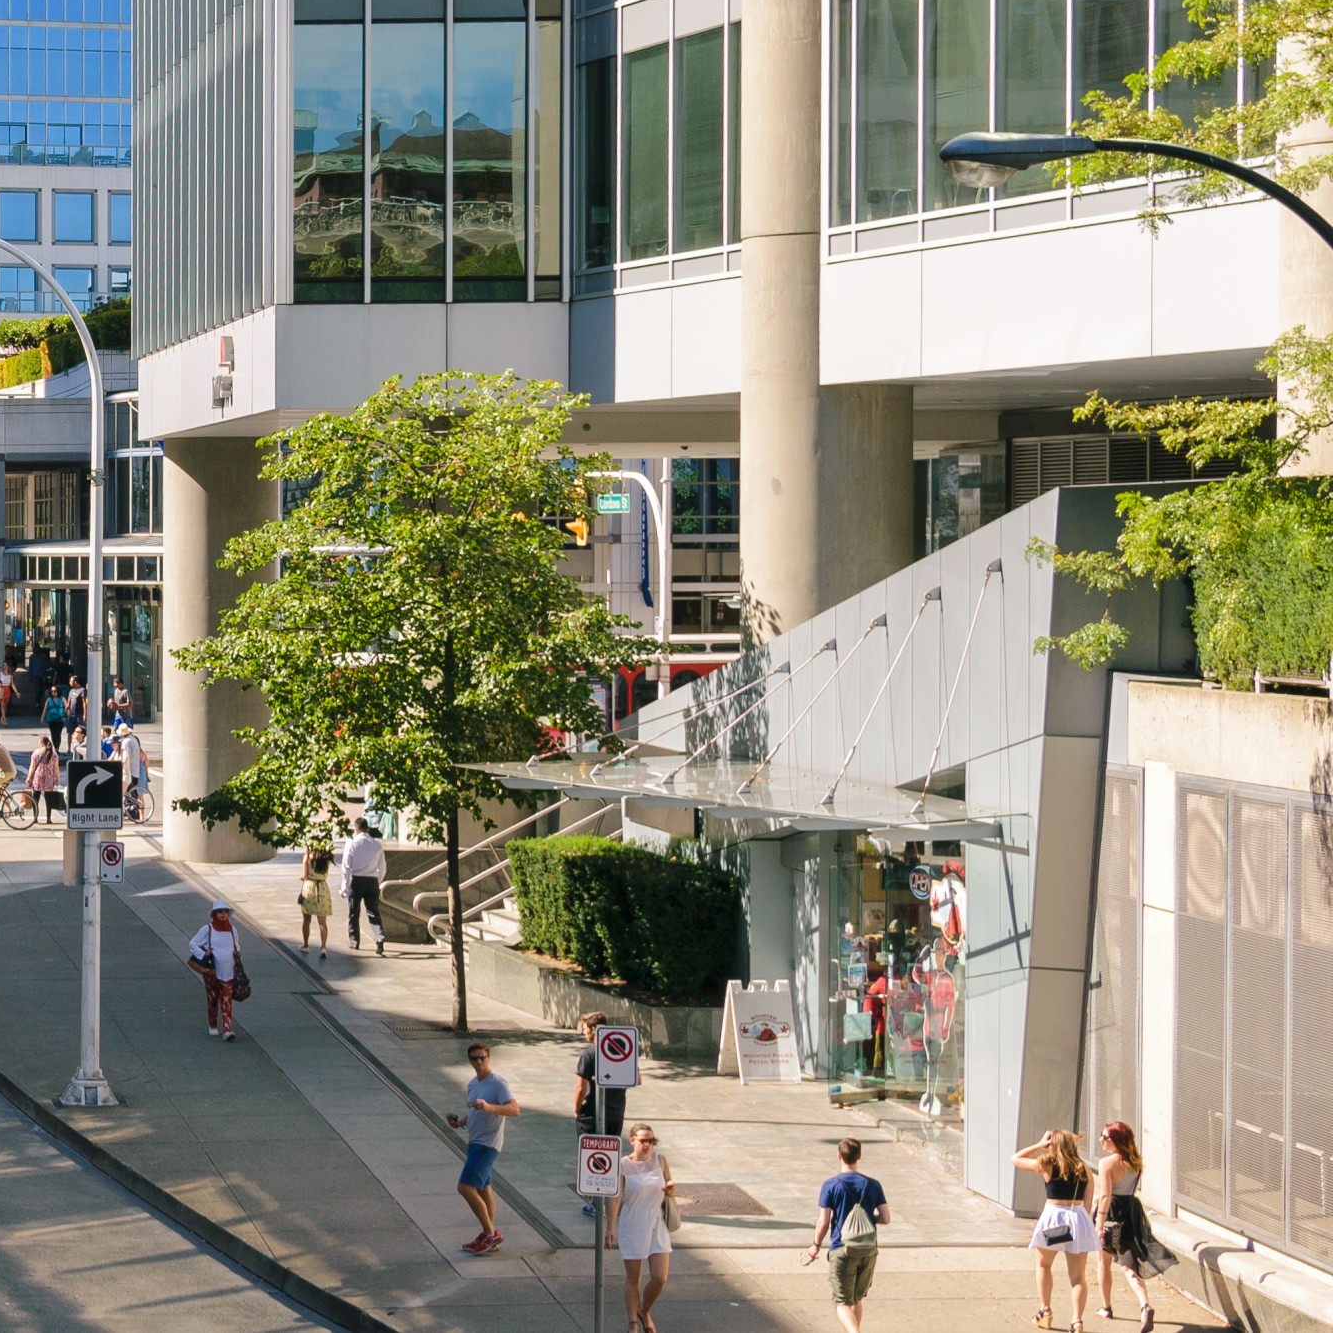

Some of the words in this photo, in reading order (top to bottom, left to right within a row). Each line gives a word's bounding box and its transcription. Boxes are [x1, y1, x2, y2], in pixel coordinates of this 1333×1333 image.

[72, 813, 95, 824] Right
[98, 813, 119, 822] Lane
[583, 1138, 618, 1150] TEMPORARY
